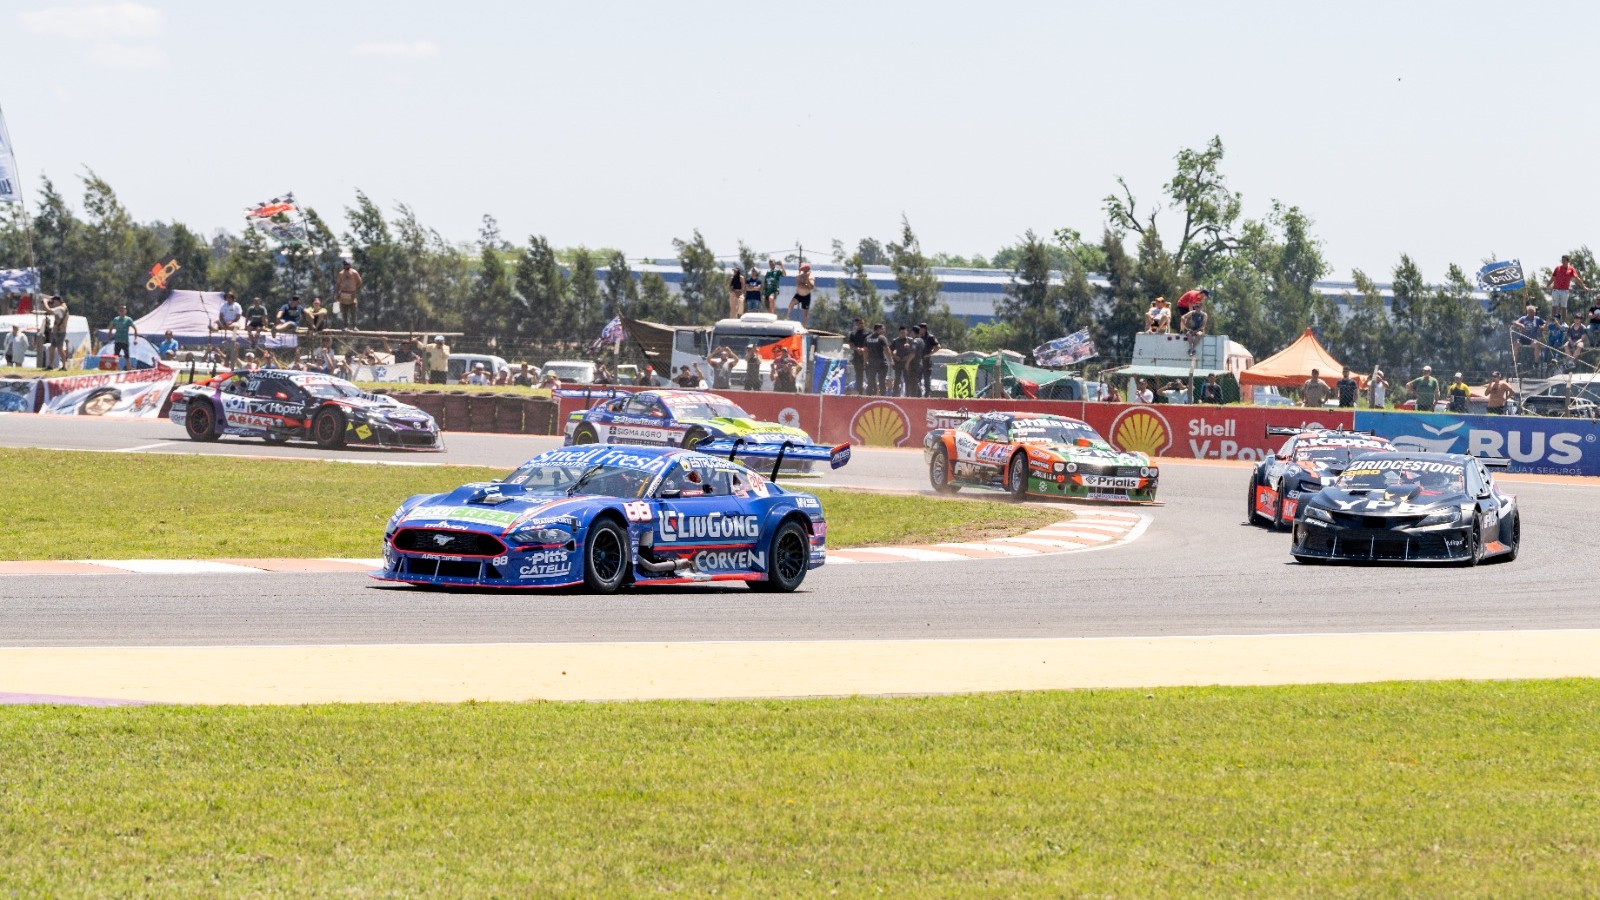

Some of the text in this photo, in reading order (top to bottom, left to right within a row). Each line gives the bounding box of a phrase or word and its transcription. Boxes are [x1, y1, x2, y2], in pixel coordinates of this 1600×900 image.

[270, 402, 304, 416] Hopex
[227, 413, 271, 427] ARIAS
[640, 430, 662, 438] AGRO
[1188, 418, 1236, 437] Shell
[1469, 430, 1582, 464] RUS
[537, 448, 665, 472] Smell Fresh
[1347, 460, 1463, 475] BRIDGESTONE
[1536, 466, 1582, 475] SEGUROS
[623, 501, 652, 521] 88
[492, 556, 508, 567] 88
[694, 550, 766, 572] CORVEN
[519, 562, 572, 576] CATELLI
